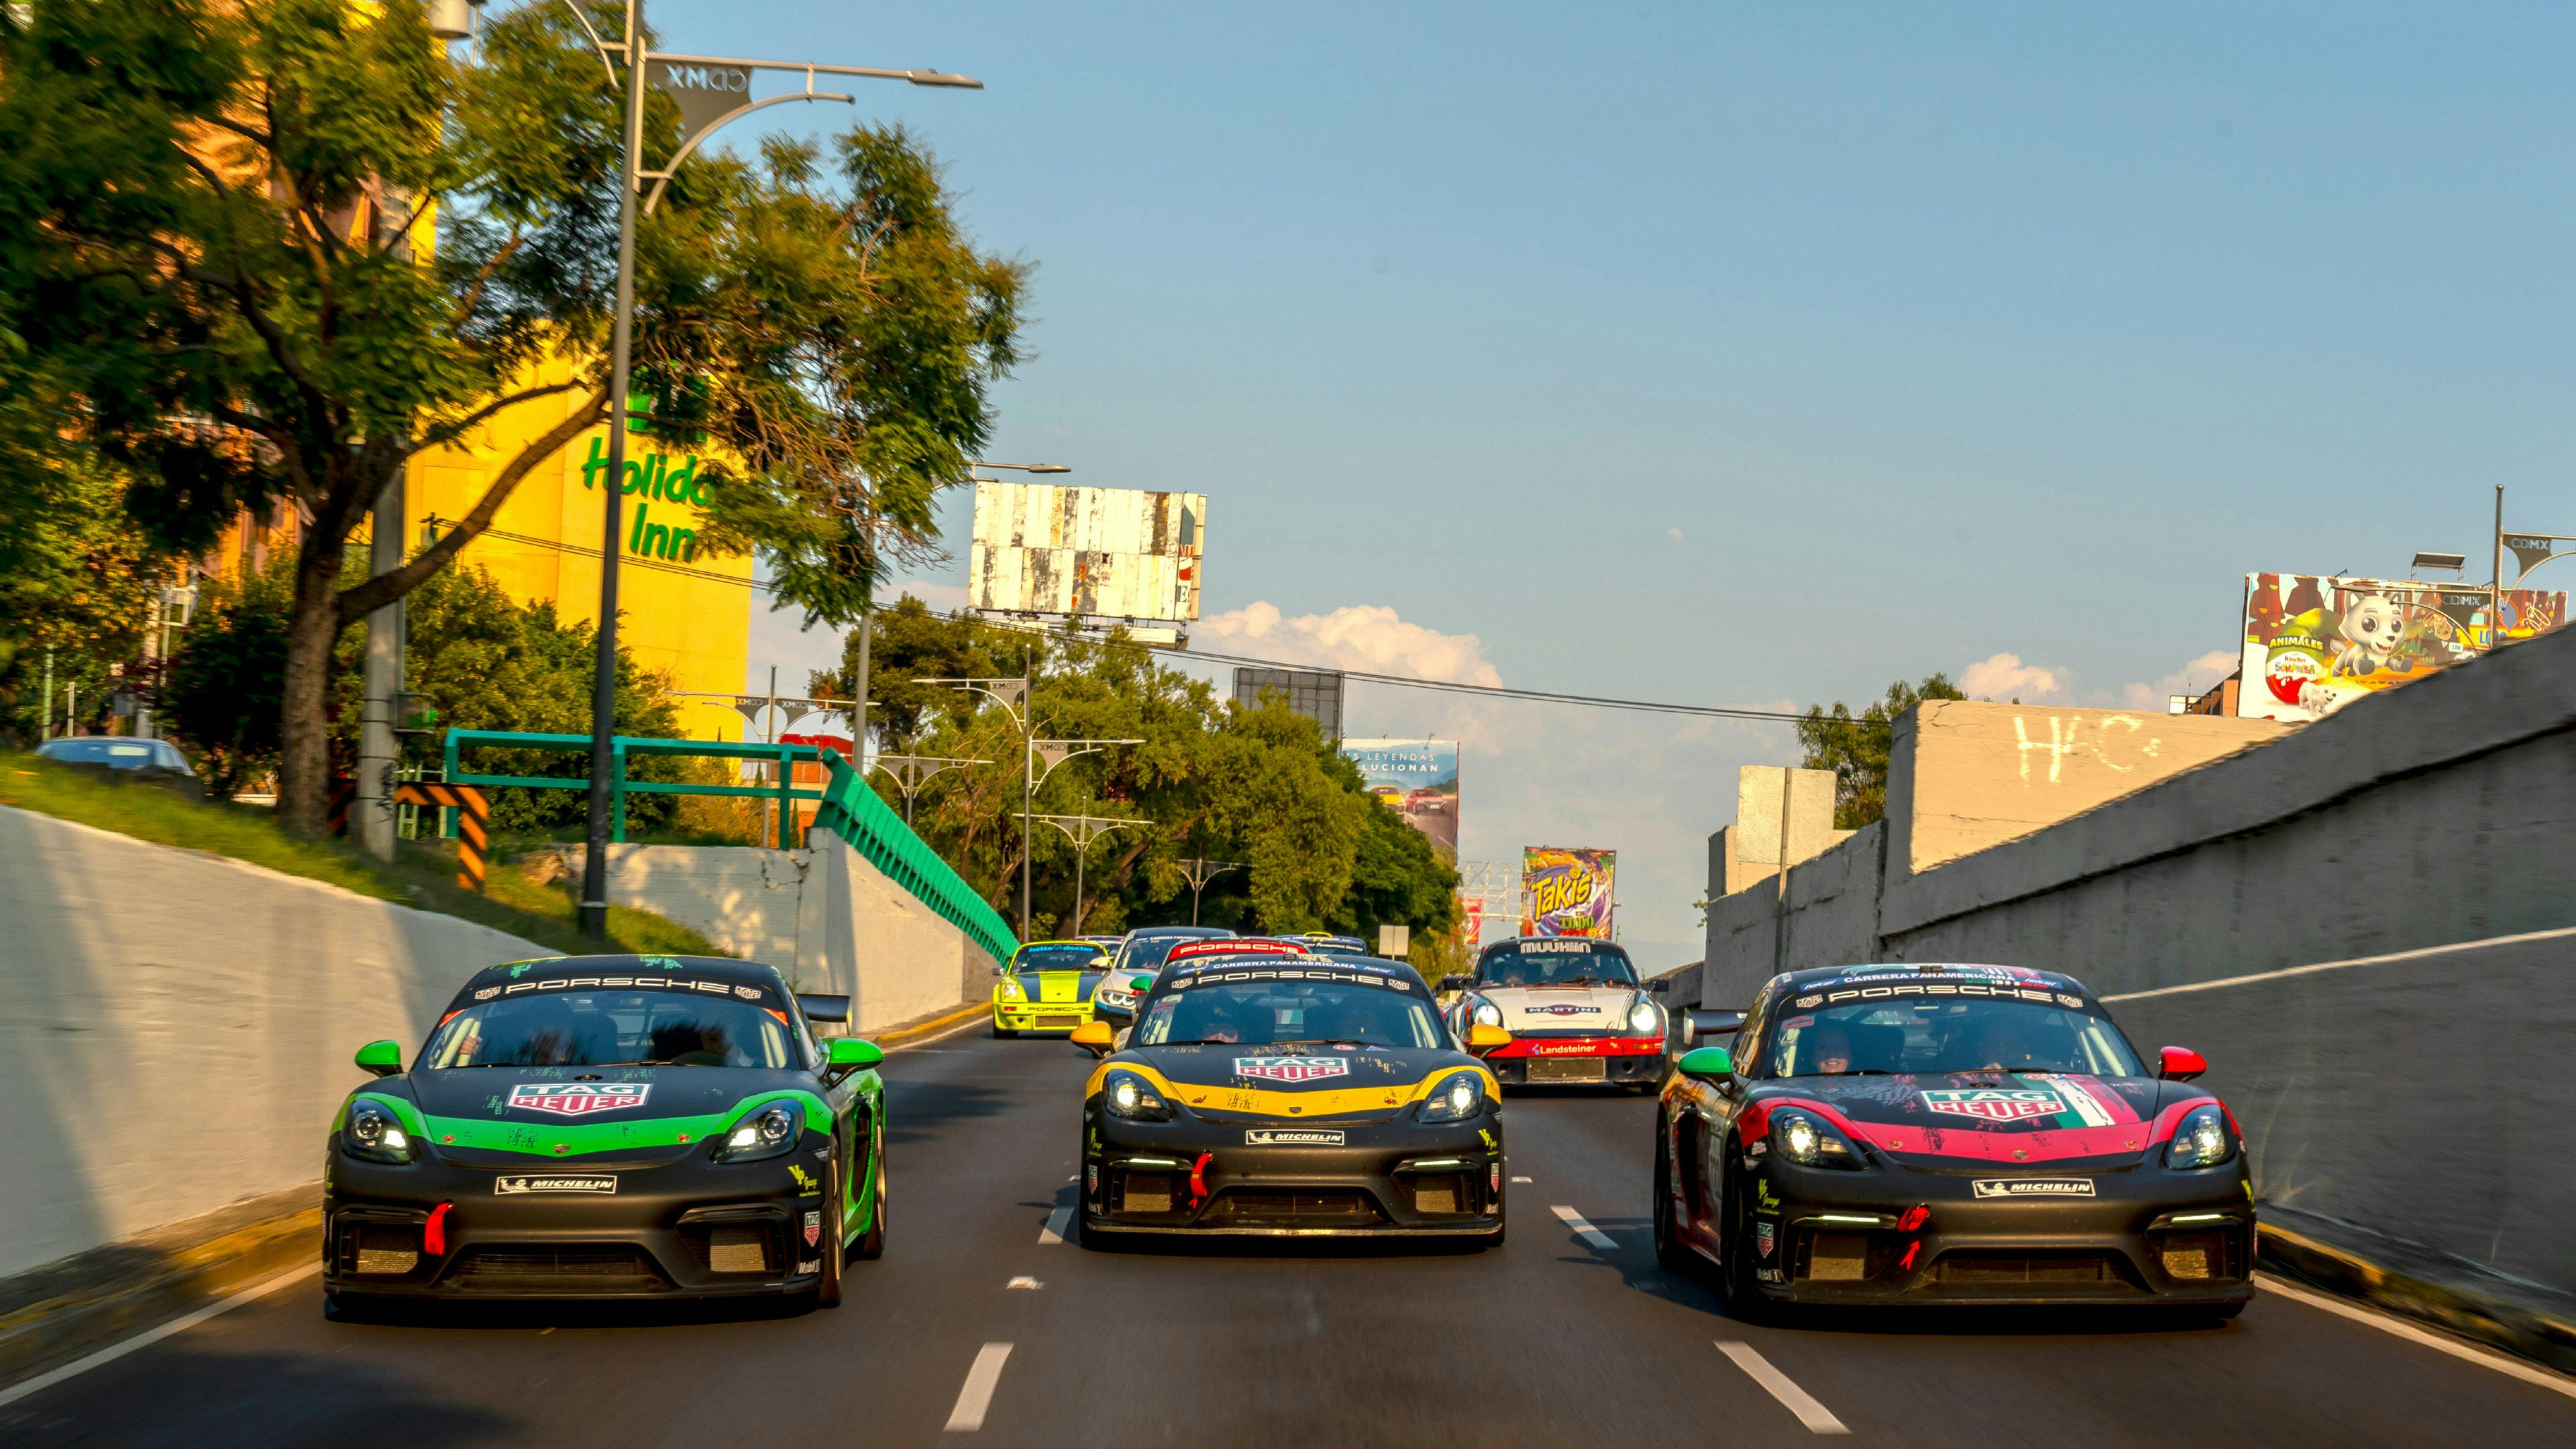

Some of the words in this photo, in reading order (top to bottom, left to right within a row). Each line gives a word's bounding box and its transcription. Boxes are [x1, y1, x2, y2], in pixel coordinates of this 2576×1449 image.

[629, 502, 695, 564] Inn
[2511, 538, 2549, 550] CDMX
[1367, 753, 1434, 761] LEYENDAS
[1531, 866, 1591, 922] Takis
[1180, 943, 1299, 955] PORSCHE
[1213, 961, 1267, 969] CARRERA
[1269, 960, 1356, 969] PANAMERICANA
[1197, 971, 1384, 985] PORSCHE
[1843, 973, 1909, 983] CARRERA
[1911, 972, 2017, 981] PANAMERICANA
[504, 977, 730, 994] PORSCHE
[1827, 985, 2053, 1003] PORSCHE
[1540, 1044, 1597, 1054] Landsteiner
[1244, 1067, 1341, 1079] HEUER
[527, 1085, 635, 1095] TAG
[1934, 1091, 2049, 1101] TAG
[519, 1096, 636, 1112] HEUER
[1936, 1102, 2059, 1118] HEUER
[1275, 1133, 1342, 1141] MICHELIN
[531, 1180, 613, 1188] MICHELIN
[2010, 1183, 2090, 1192] MICHELIN
[807, 1214, 819, 1226] TAG
